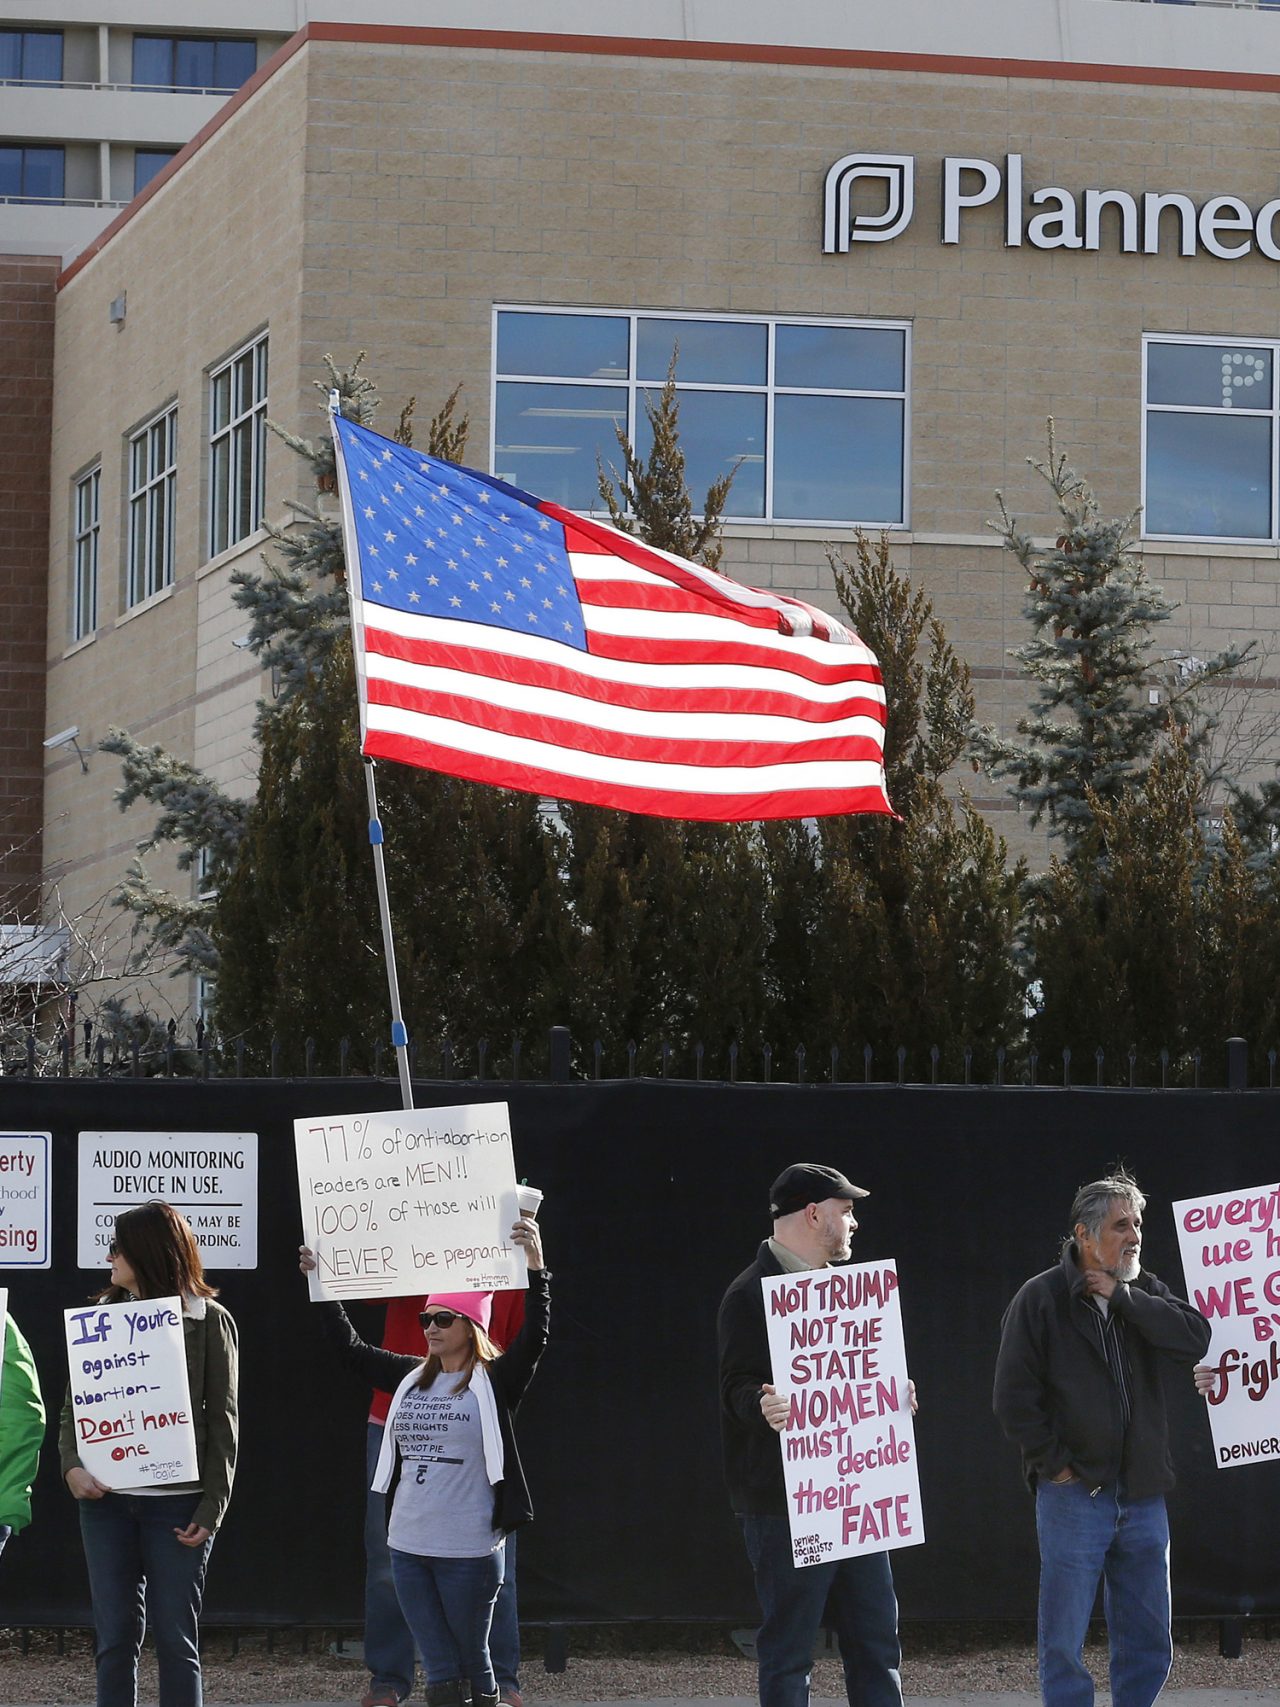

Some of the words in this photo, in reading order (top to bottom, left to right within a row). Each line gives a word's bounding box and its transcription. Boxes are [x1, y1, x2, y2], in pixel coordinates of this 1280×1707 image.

[382, 1127, 401, 1155] of
[93, 1150, 141, 1169] AUDIO
[147, 1151, 244, 1170] MONITORING
[113, 1175, 164, 1193] DEVICE
[171, 1176, 186, 1193] IN
[193, 1176, 223, 1194] USE.
[310, 1176, 369, 1197] leaders
[375, 1177, 401, 1189] are
[197, 1215, 222, 1228] MAY
[227, 1215, 240, 1228] BE
[315, 1200, 378, 1236] 100%
[388, 1200, 408, 1222] of
[414, 1199, 460, 1217] those
[467, 1195, 496, 1211] will
[316, 1246, 398, 1280] NEVER
[411, 1245, 438, 1269] be
[444, 1242, 512, 1270] pregnant
[1202, 1238, 1253, 1267] we
[771, 1277, 813, 1317] NOT
[814, 1269, 899, 1313] TRUMP
[1194, 1277, 1260, 1319] WE
[70, 1310, 112, 1345] If
[790, 1315, 838, 1350] NOT
[841, 1317, 883, 1348] THE
[82, 1350, 150, 1380] against
[790, 1348, 880, 1385] STATE
[395, 1412, 414, 1420] OES
[416, 1412, 437, 1420] NOT
[440, 1413, 470, 1422] MEAN
[414, 1403, 452, 1411] OTHERS
[78, 1410, 135, 1440] Don't
[141, 1410, 189, 1431] have
[413, 1423, 449, 1432] RIGHTS
[111, 1443, 149, 1461] one
[786, 1420, 849, 1462] must
[837, 1424, 911, 1476] decide
[793, 1477, 861, 1515] their
[842, 1494, 912, 1546] FATE
